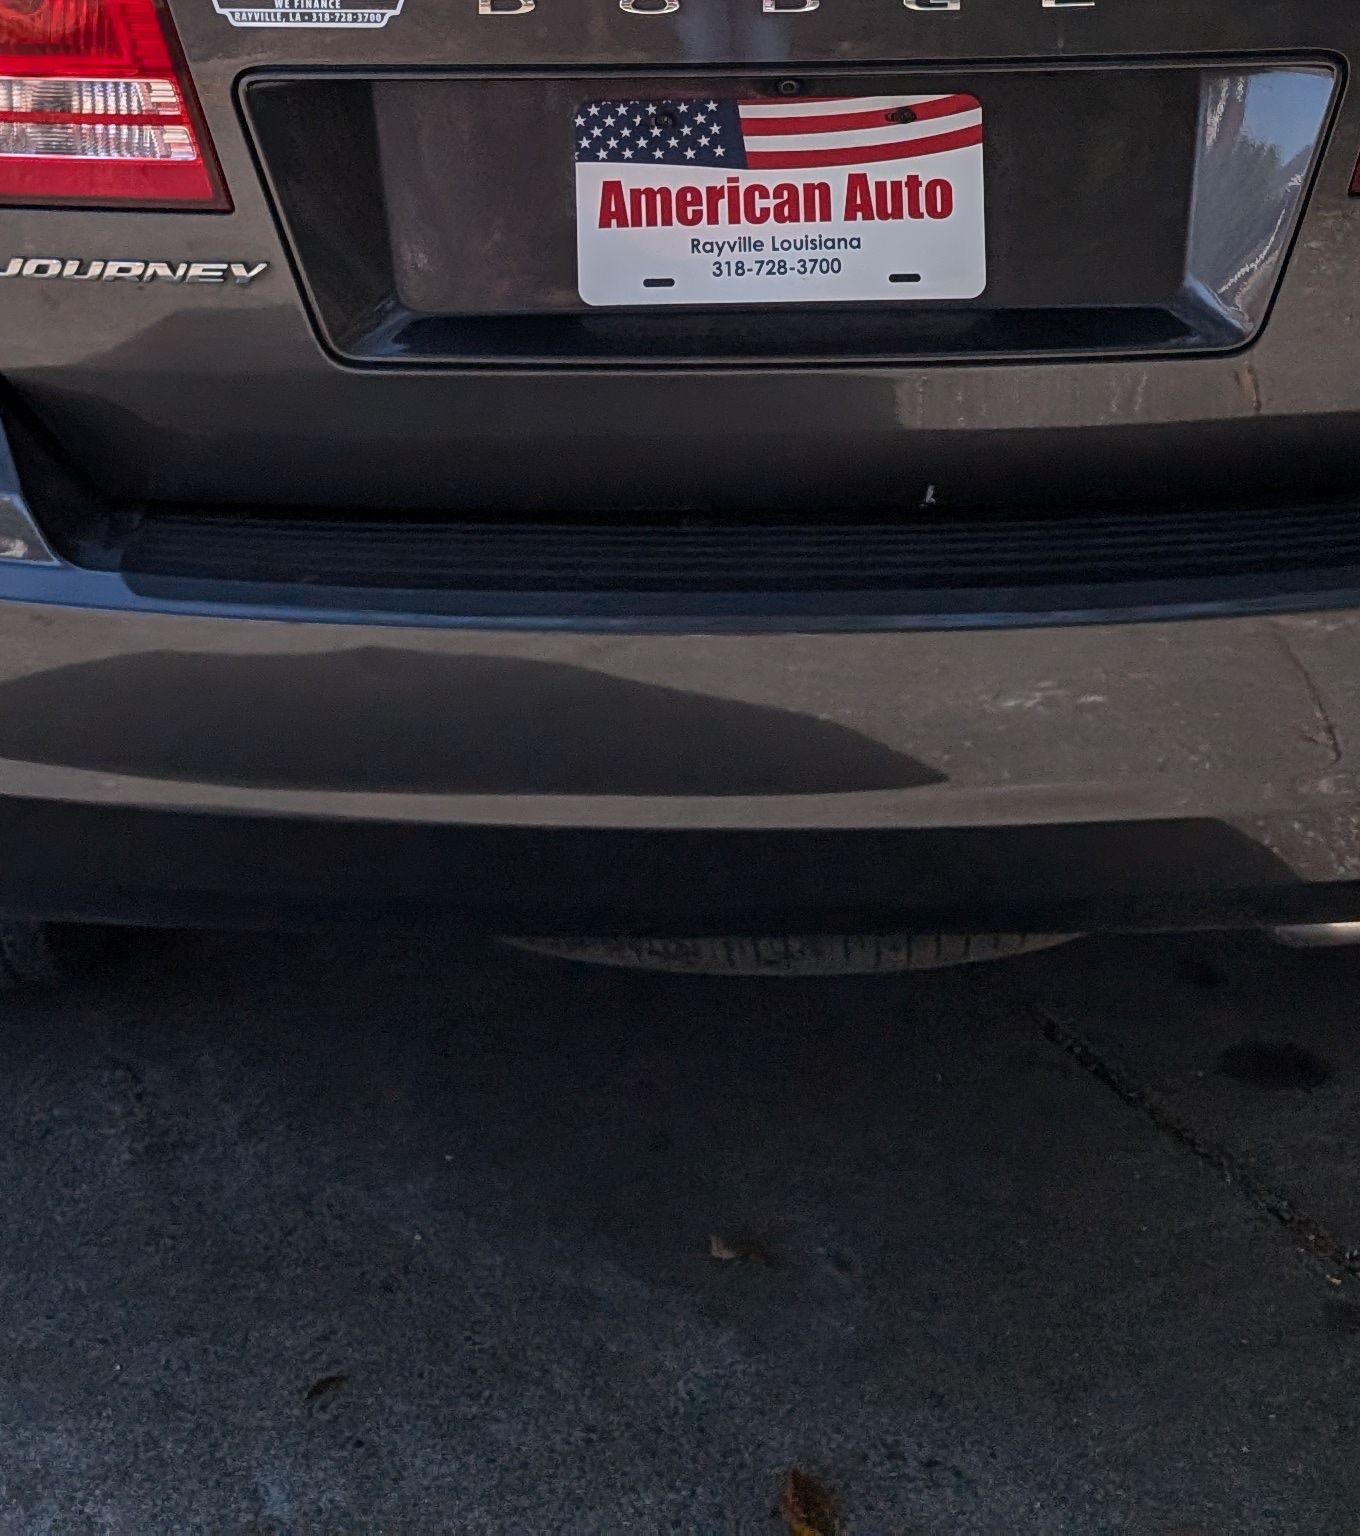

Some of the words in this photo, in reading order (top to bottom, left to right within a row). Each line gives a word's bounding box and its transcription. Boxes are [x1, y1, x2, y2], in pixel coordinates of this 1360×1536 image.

[234, 11, 286, 23] RAYVILLE,
[289, 12, 302, 23] LA
[598, 176, 833, 229] American
[843, 172, 954, 222] Auto
[690, 236, 765, 257] Rayville
[771, 234, 862, 253] Louisiana
[712, 258, 842, 278] 318-728-3700
